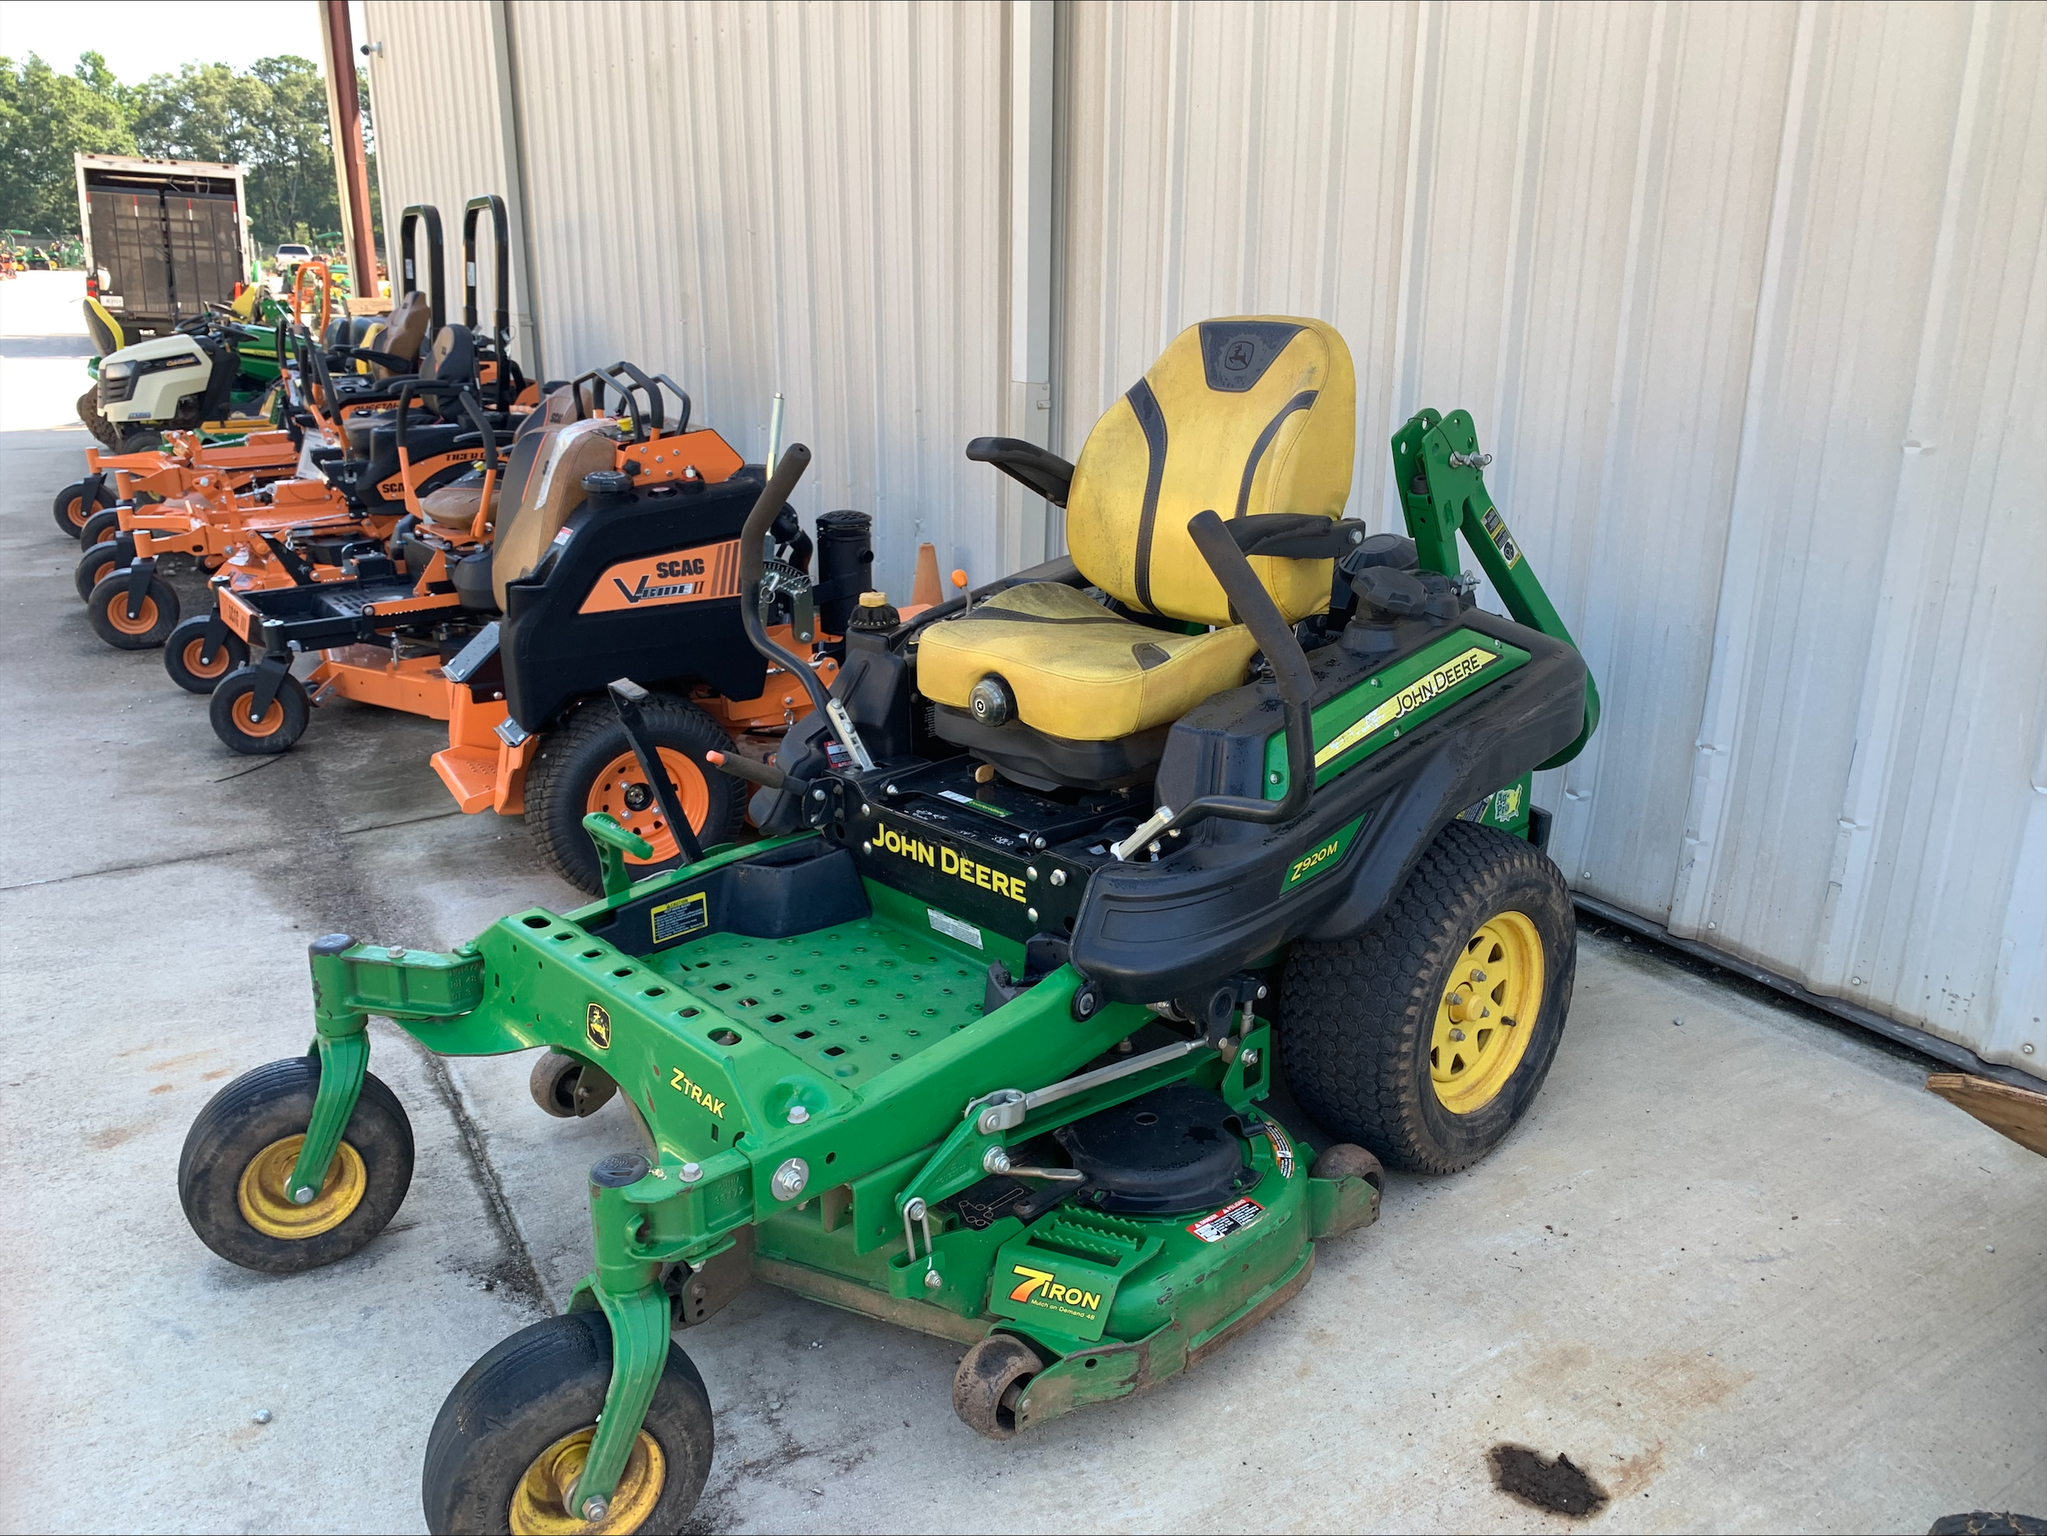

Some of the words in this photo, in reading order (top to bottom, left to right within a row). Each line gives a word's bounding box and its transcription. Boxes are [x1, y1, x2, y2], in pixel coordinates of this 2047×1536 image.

[382, 483, 405, 494] SCA
[656, 558, 705, 579] SCAG
[1395, 682, 1434, 718] JOHN
[1433, 653, 1481, 690] DEERE
[872, 822, 935, 868] JOHN
[940, 845, 1027, 904] DEERE
[1290, 840, 1339, 882] Z920M
[1030, 1299, 1049, 1308] Mulch
[1058, 1306, 1085, 1318] Demand
